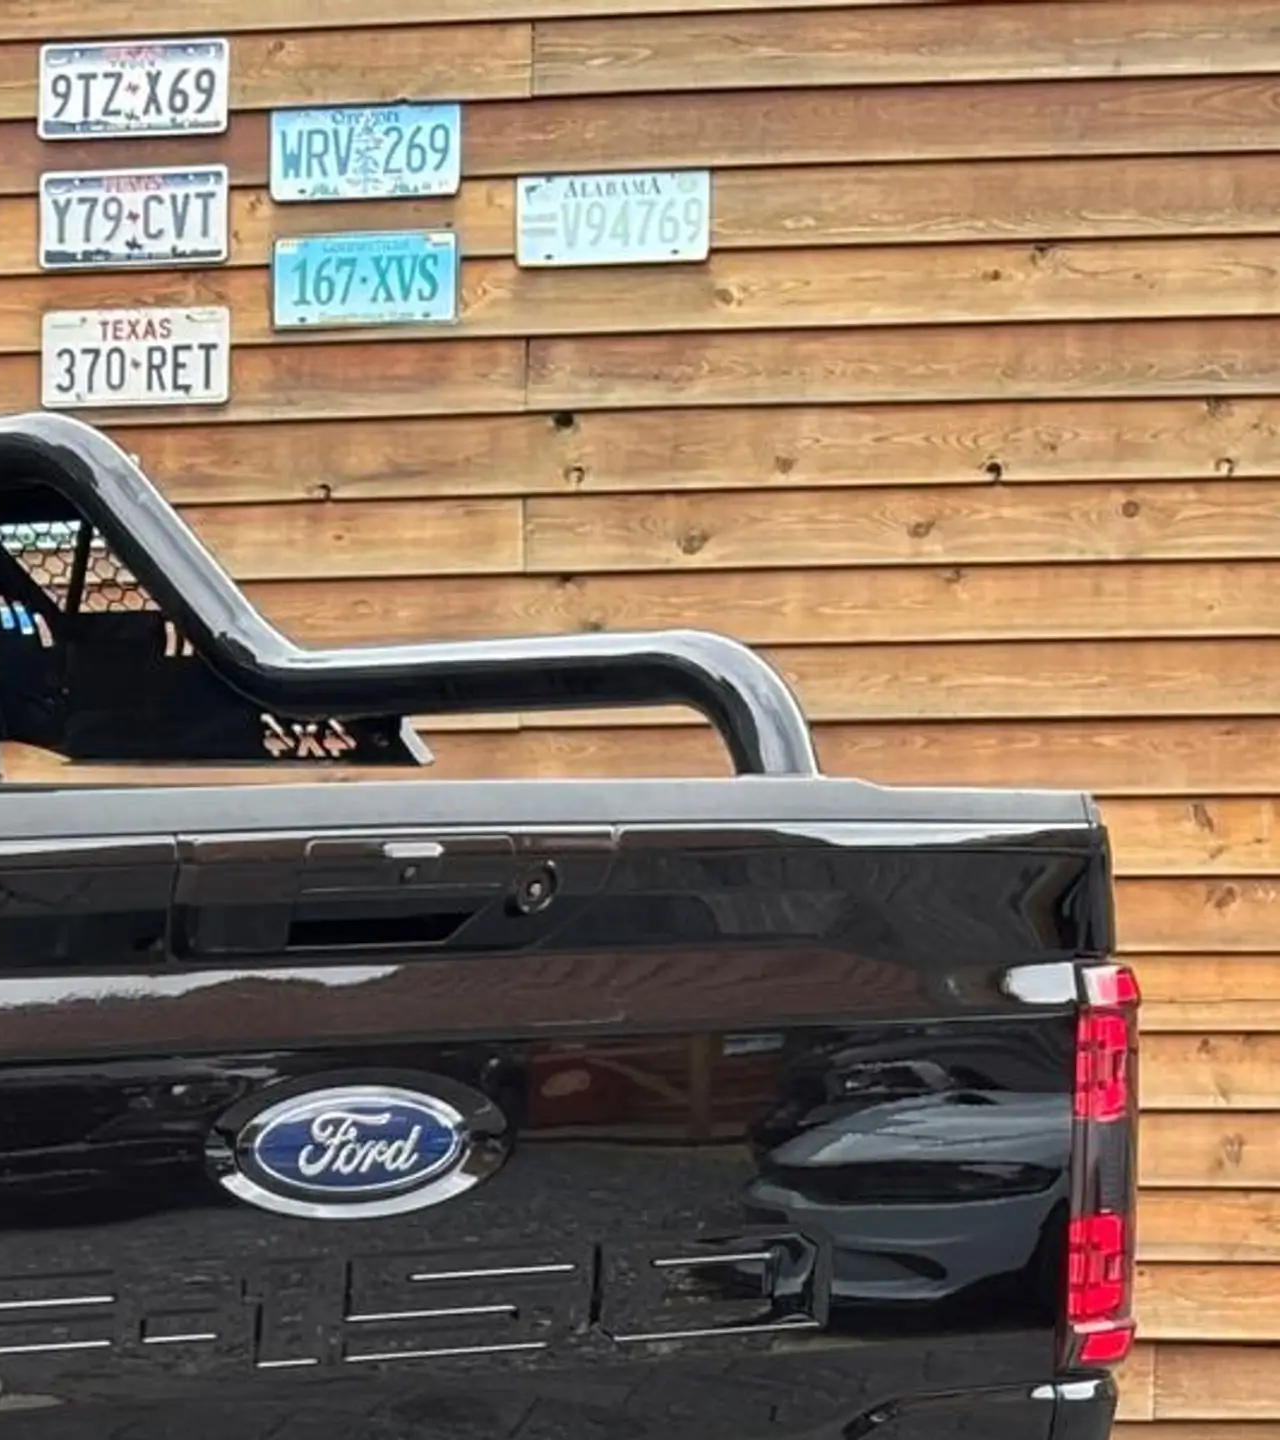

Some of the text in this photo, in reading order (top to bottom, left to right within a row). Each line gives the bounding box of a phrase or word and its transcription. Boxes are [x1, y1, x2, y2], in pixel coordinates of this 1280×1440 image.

[564, 175, 662, 199] ALABAMA
[99, 317, 173, 342] TEXAS
[297, 1111, 423, 1177] Ford
